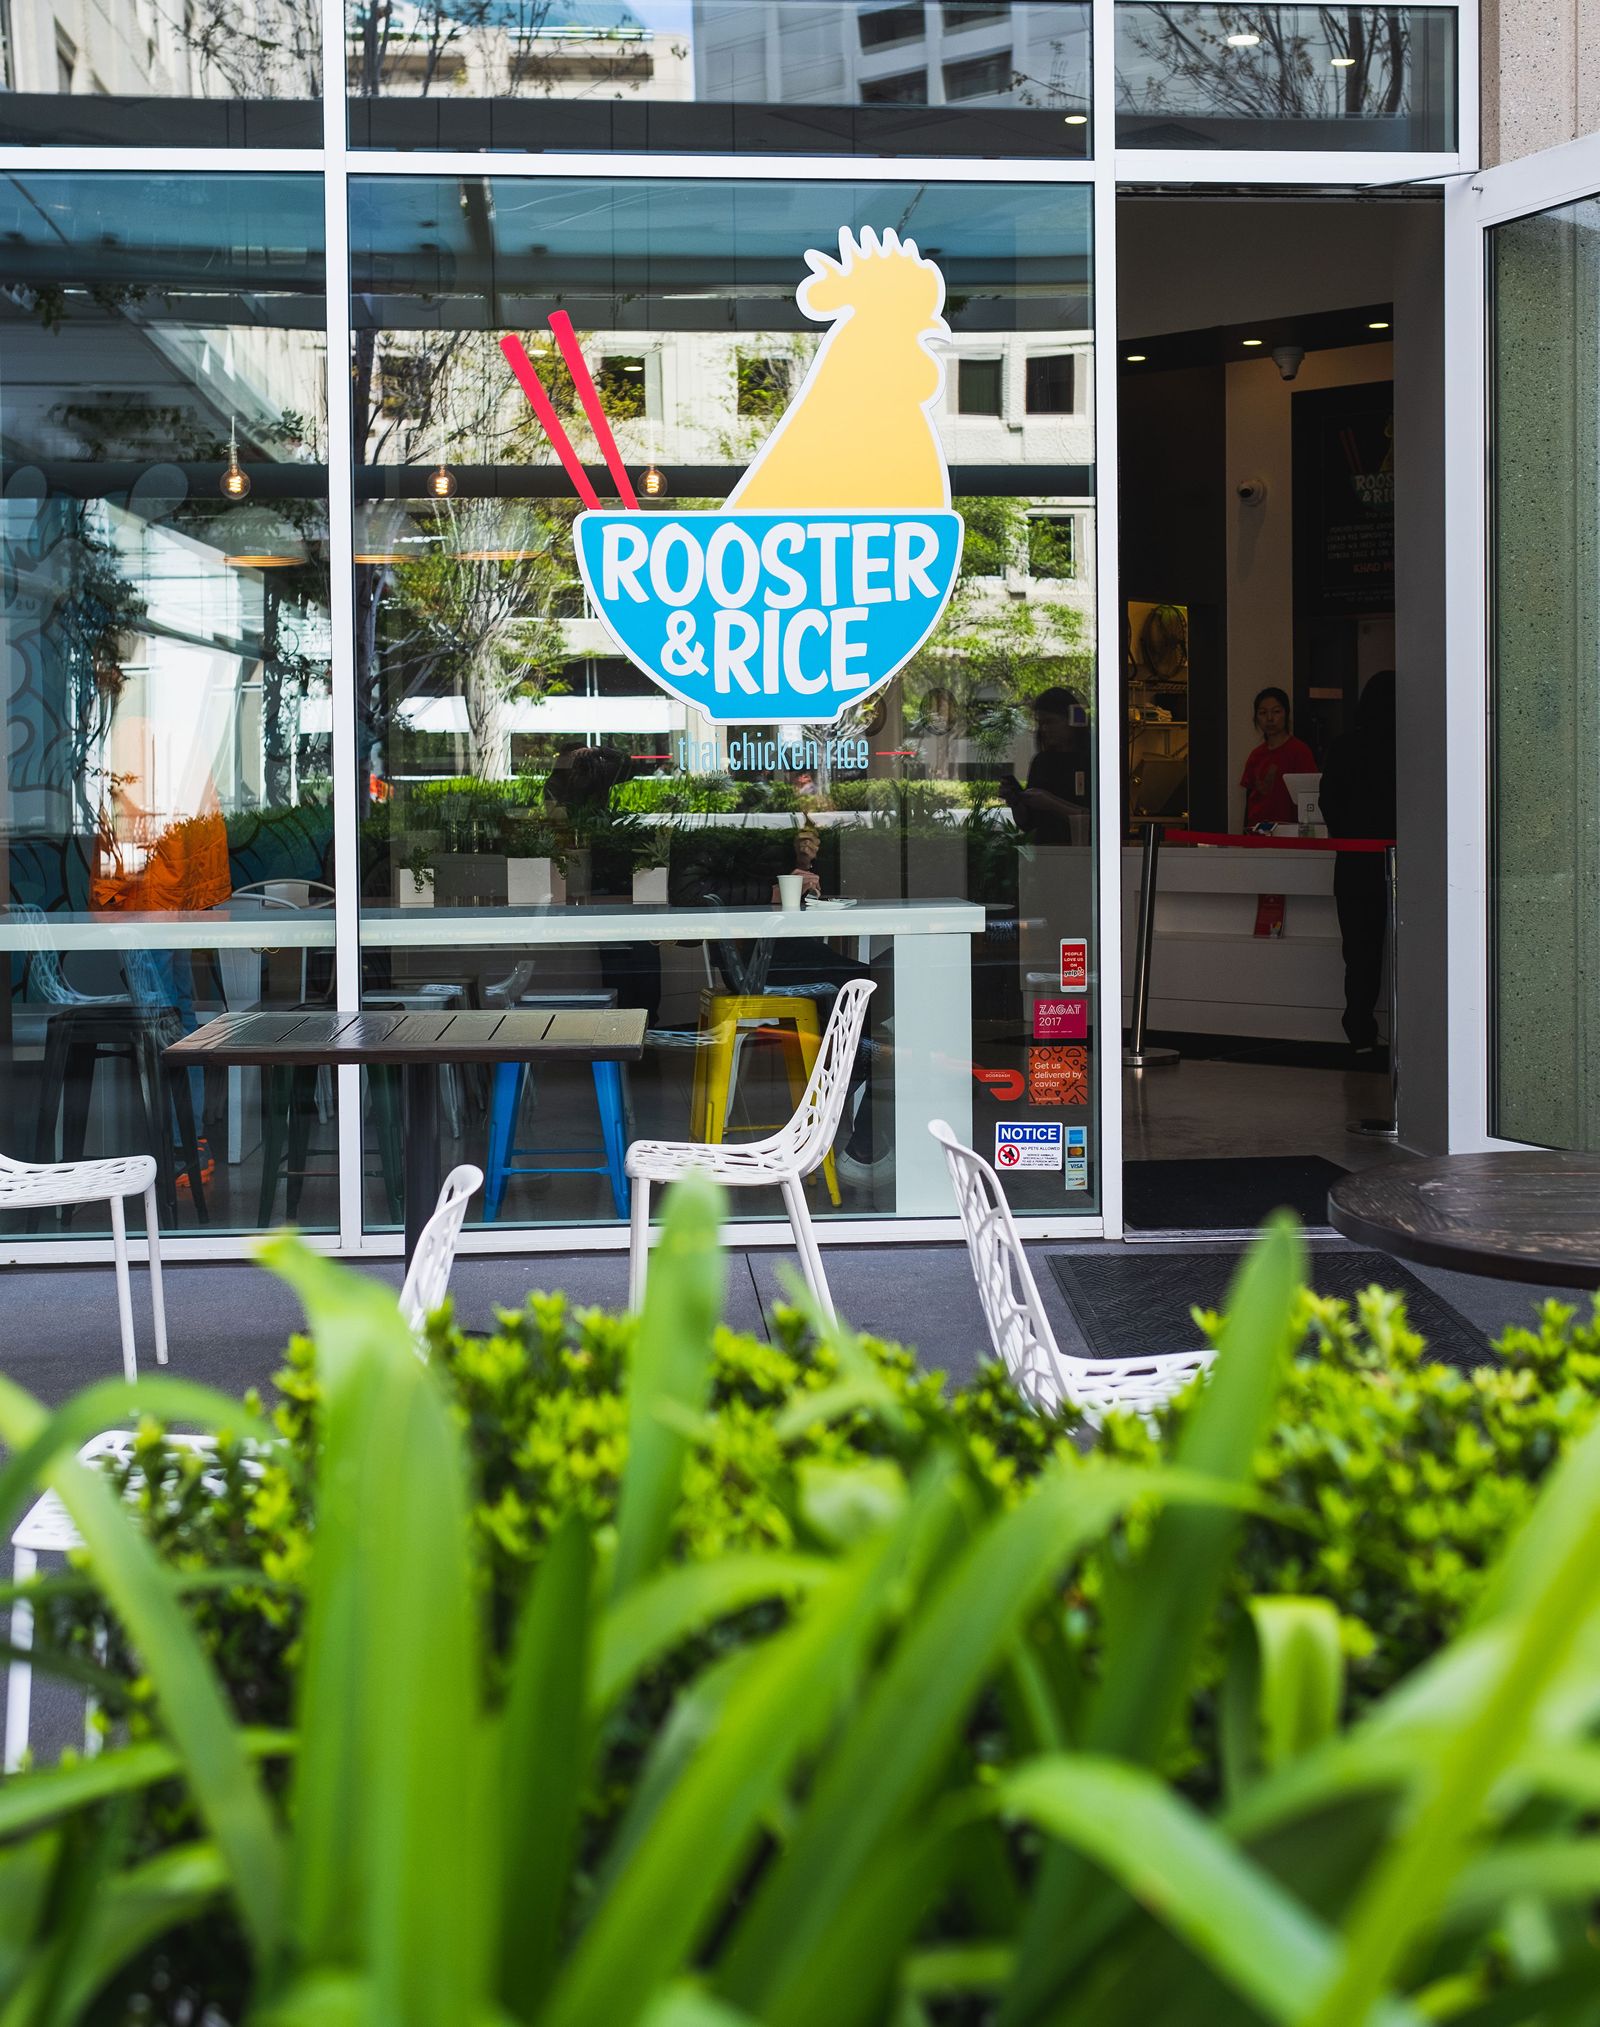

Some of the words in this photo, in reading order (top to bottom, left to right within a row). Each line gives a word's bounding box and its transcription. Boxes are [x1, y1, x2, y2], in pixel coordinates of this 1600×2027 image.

[602, 522, 940, 609] ROOSTER
[678, 732, 720, 771] thai
[729, 732, 819, 771] chicken
[825, 731, 869, 770] rice
[1064, 969, 1079, 977] yelp
[1039, 1004, 1081, 1015] ZAGAT
[1039, 1017, 1062, 1026] 2017
[1034, 1071, 1070, 1079] delivered
[1072, 1071, 1082, 1080] by
[1034, 1080, 1060, 1088] caviar
[1001, 1127, 1057, 1140] NOTICE
